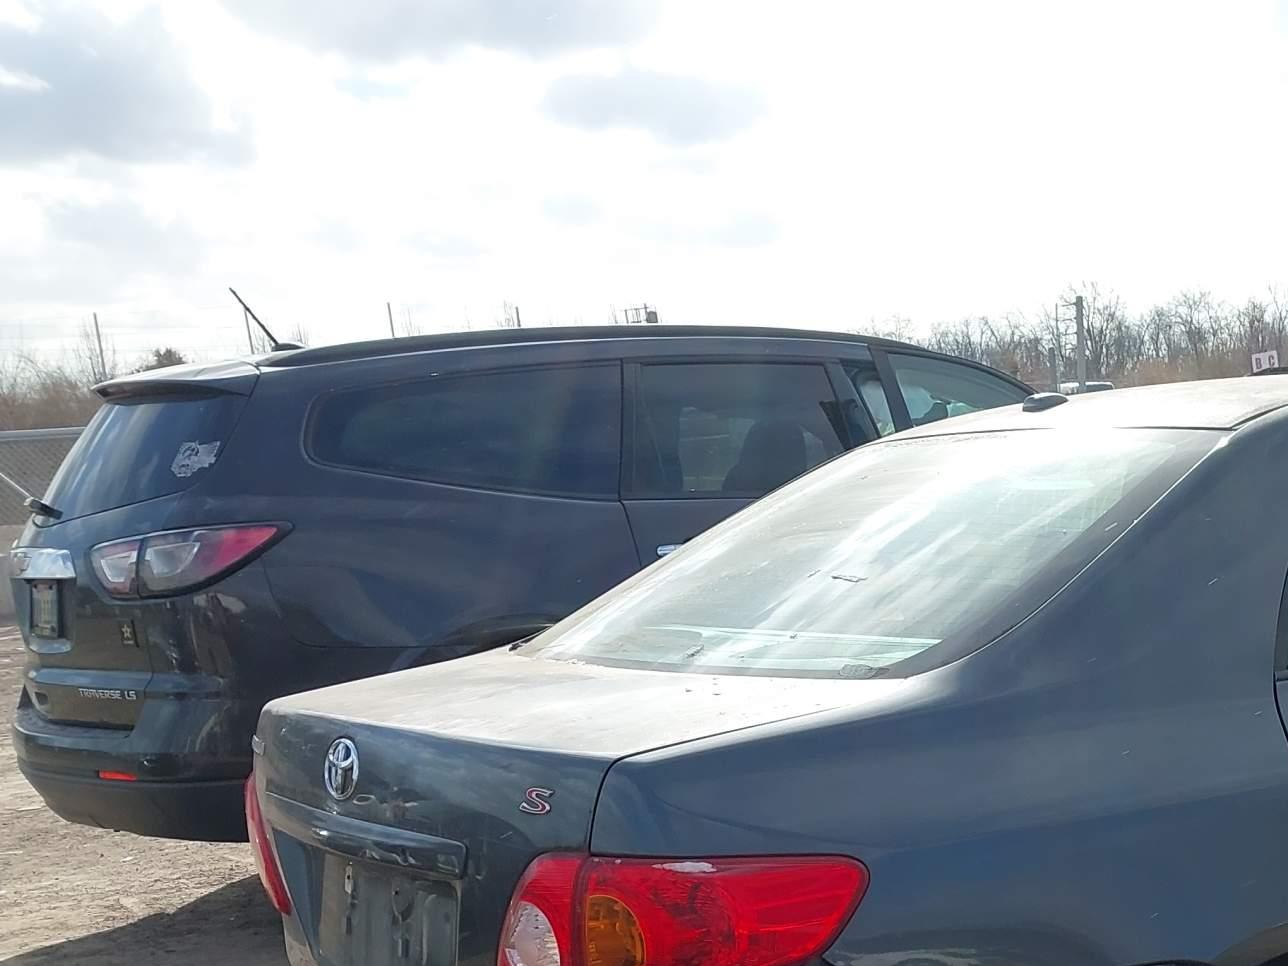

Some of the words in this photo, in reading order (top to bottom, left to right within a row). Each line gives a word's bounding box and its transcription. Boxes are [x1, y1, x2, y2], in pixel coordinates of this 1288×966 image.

[1268, 355, 1275, 367] C
[78, 687, 122, 700] TRAVERSE
[124, 690, 137, 700] LS
[519, 787, 554, 814] S
